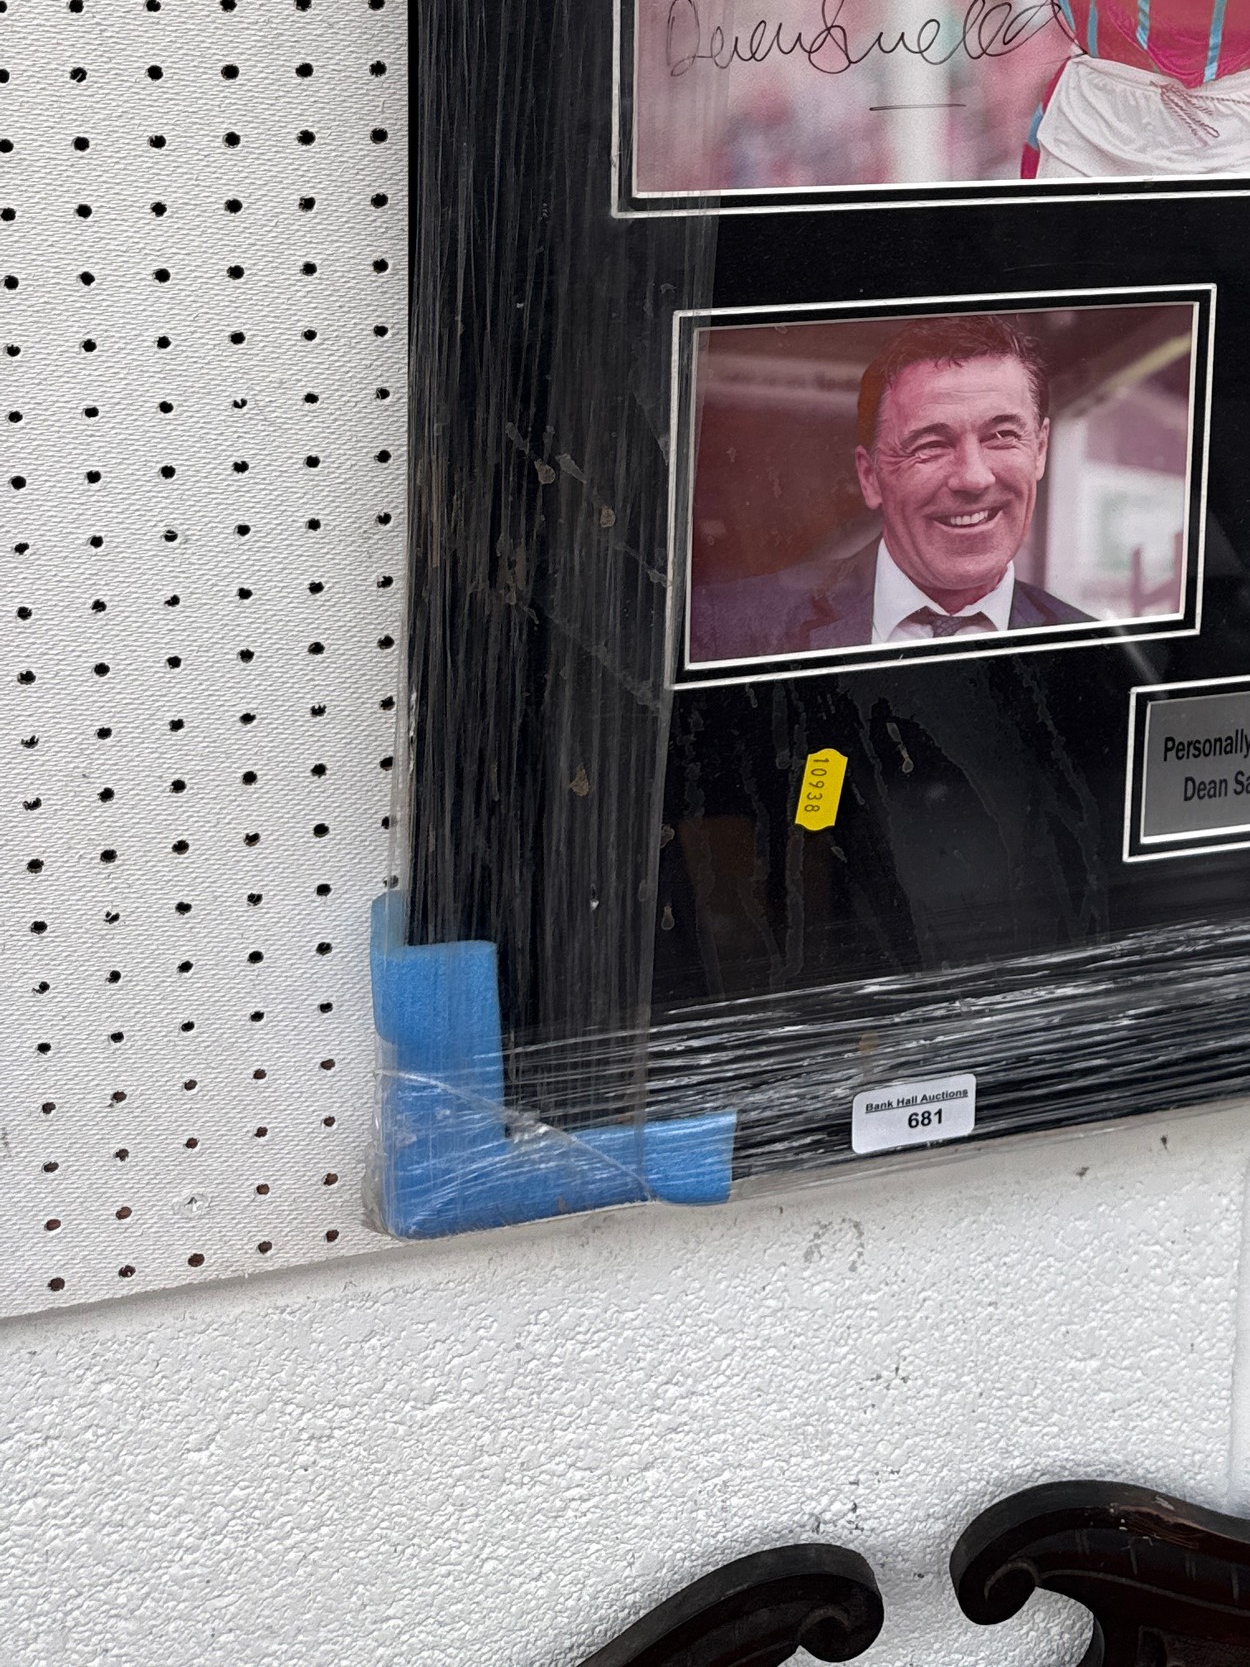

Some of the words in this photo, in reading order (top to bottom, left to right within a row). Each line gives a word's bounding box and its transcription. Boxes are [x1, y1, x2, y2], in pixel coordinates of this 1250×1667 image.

[804, 758, 830, 813] 10938
[1183, 776, 1228, 802] Dean
[865, 1099, 894, 1112] Bank
[896, 1095, 918, 1108] Hall
[920, 1088, 969, 1103] Auctions
[907, 1107, 943, 1129] 681
